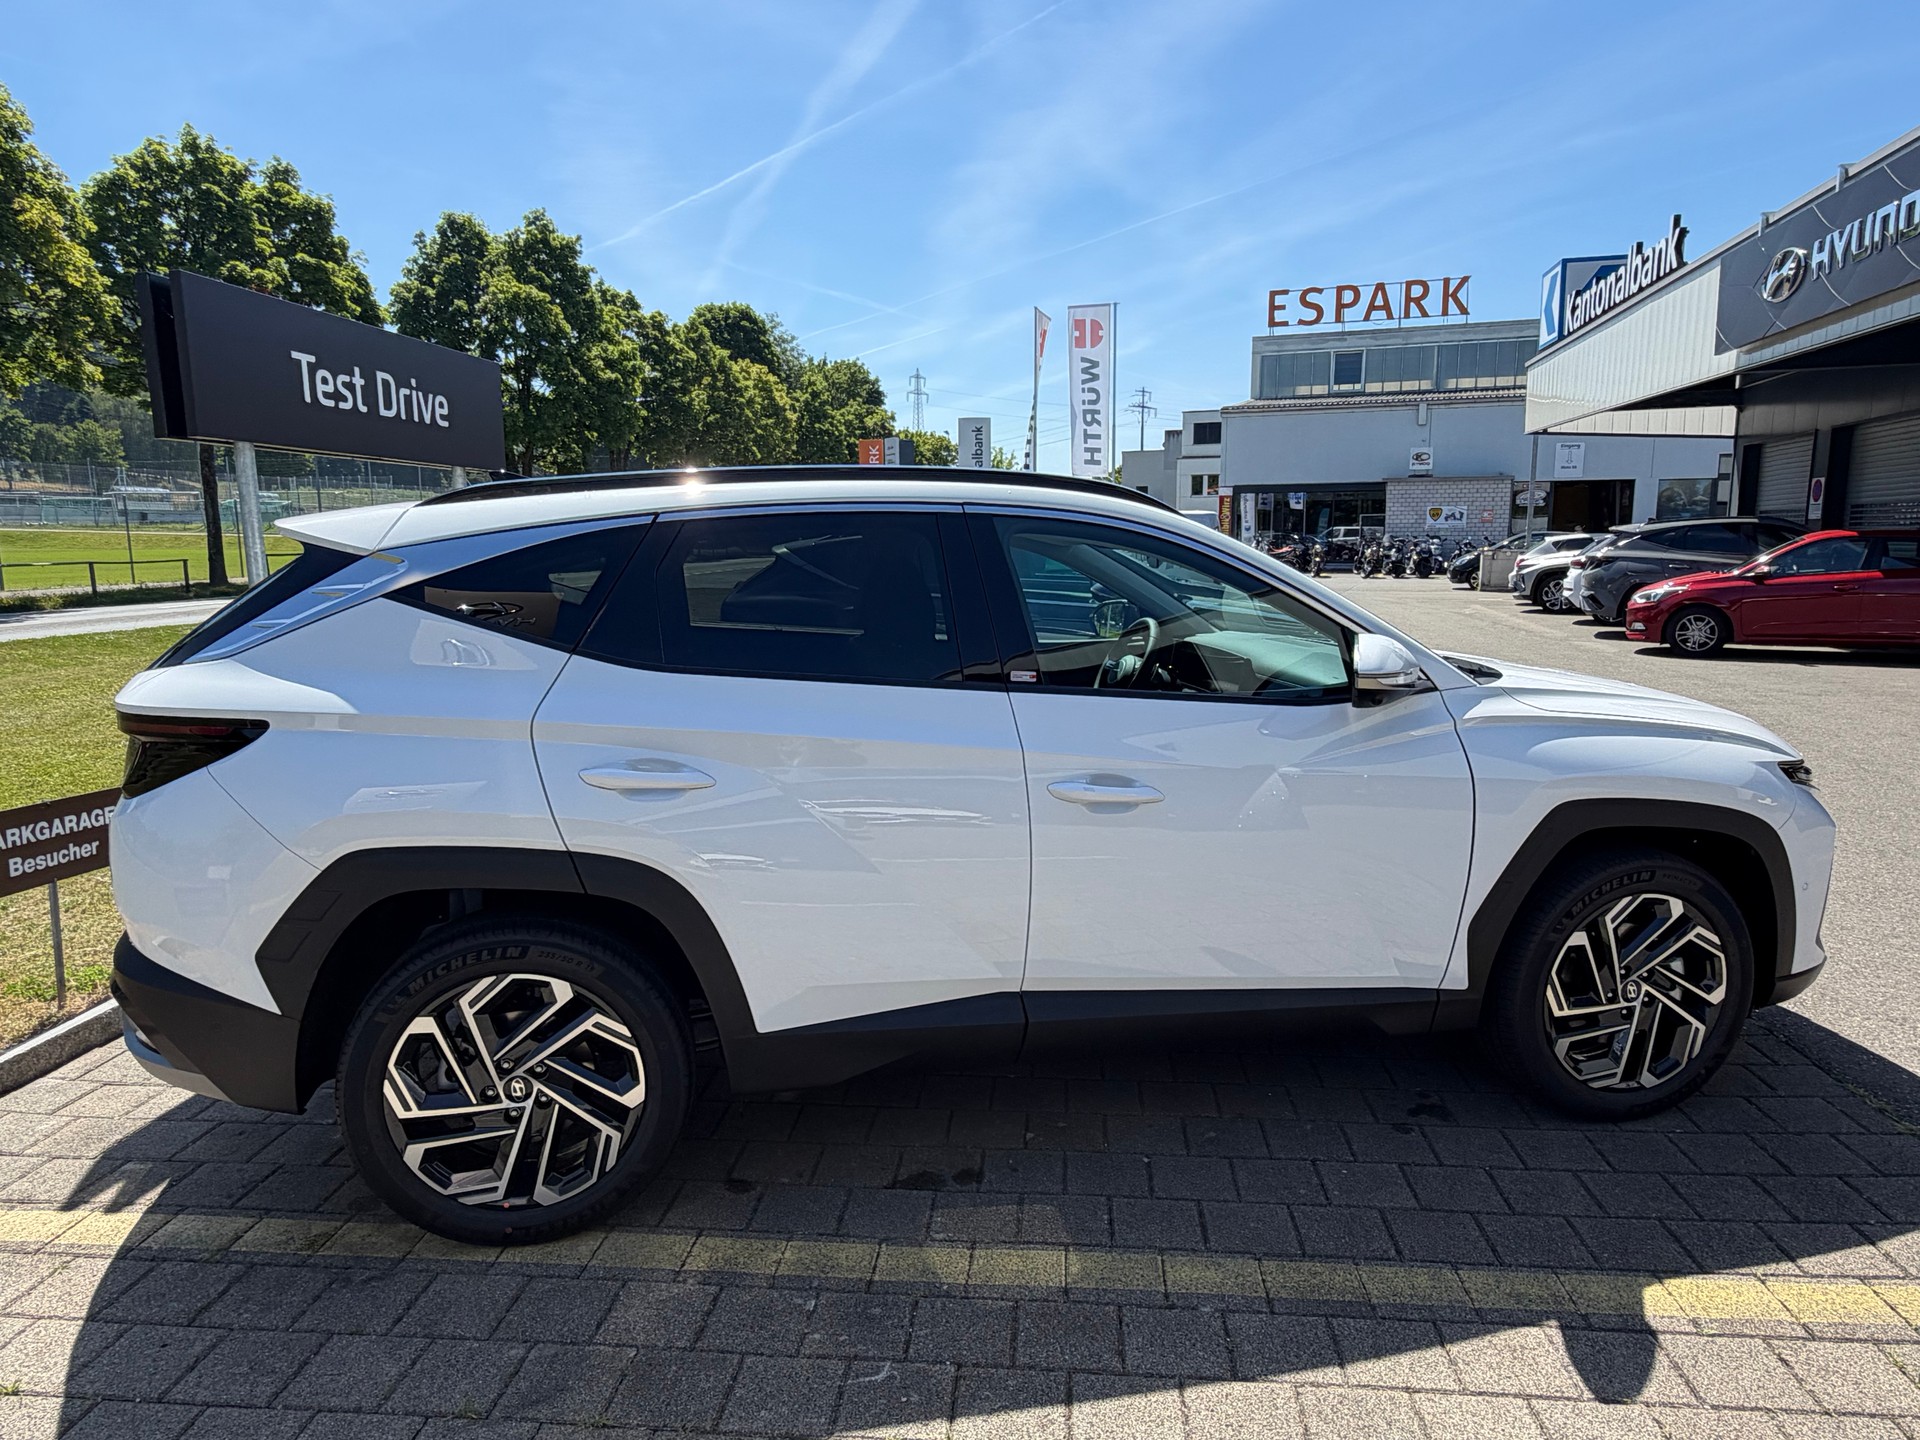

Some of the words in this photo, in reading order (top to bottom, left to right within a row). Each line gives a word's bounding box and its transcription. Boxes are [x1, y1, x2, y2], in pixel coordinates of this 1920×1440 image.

[1563, 214, 1688, 336] Kantonalbank
[1268, 275, 1471, 327] ESPARK
[290, 350, 368, 413] Test
[376, 370, 449, 427] Drive
[971, 425, 983, 468] albank
[9, 841, 99, 878] Besucher
[1571, 871, 1652, 916] MICHELIN
[407, 947, 523, 995] MICHELIN
